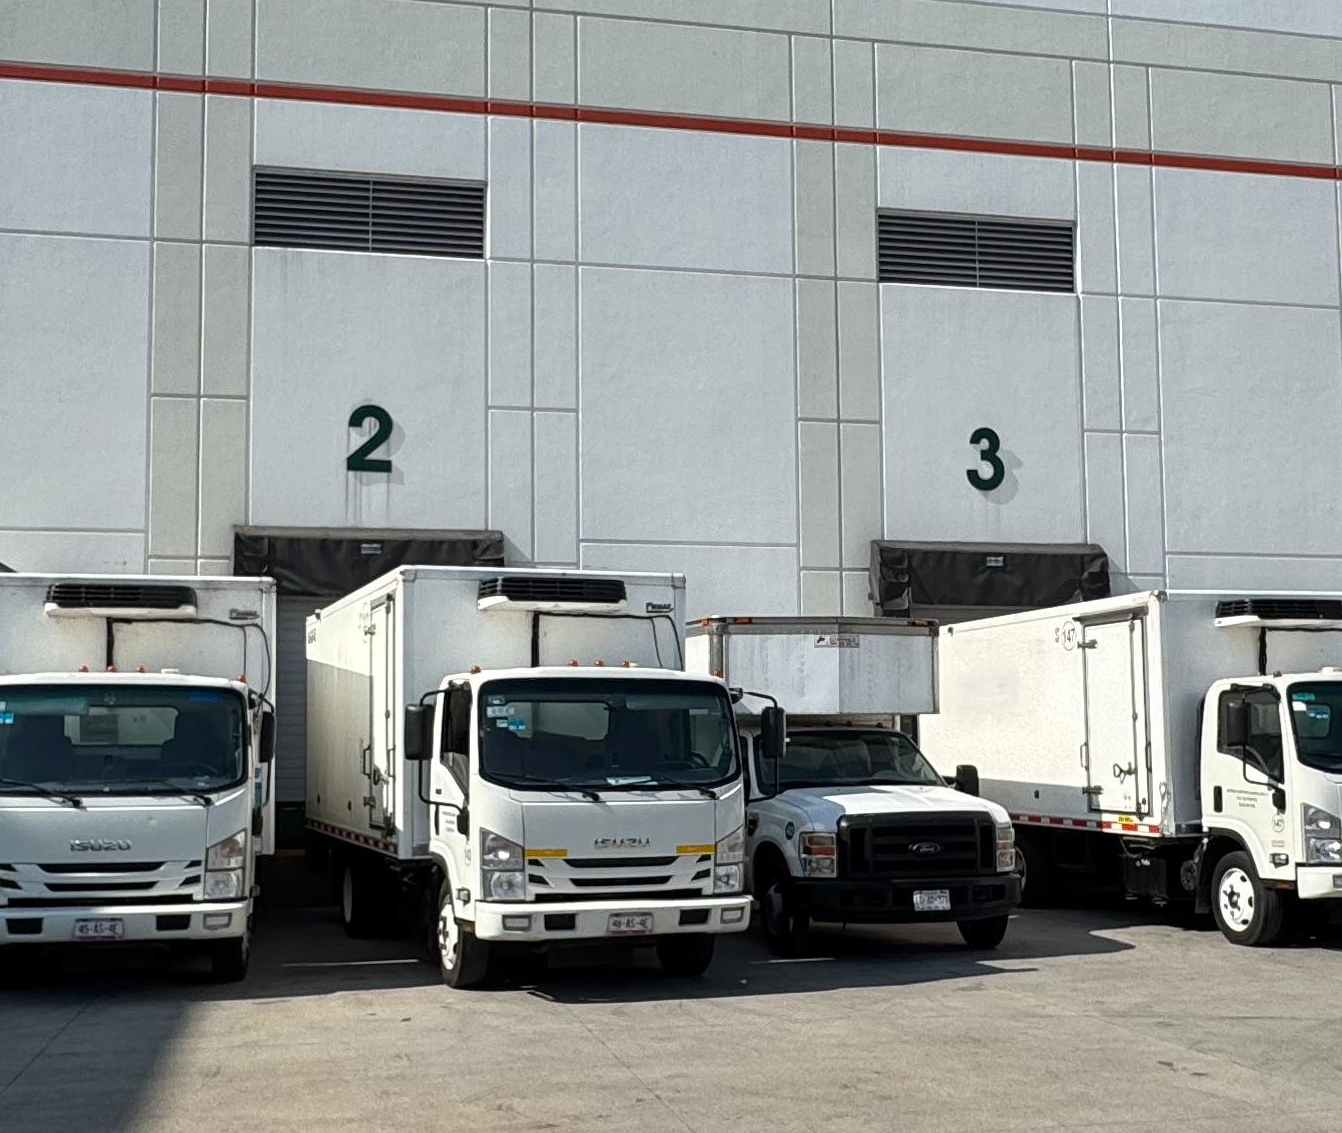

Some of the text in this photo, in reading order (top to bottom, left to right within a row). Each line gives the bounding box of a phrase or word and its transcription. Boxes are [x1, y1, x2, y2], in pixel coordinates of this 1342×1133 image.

[346, 404, 393, 473] 2
[966, 427, 1005, 492] 3
[69, 839, 132, 852] ISUZU
